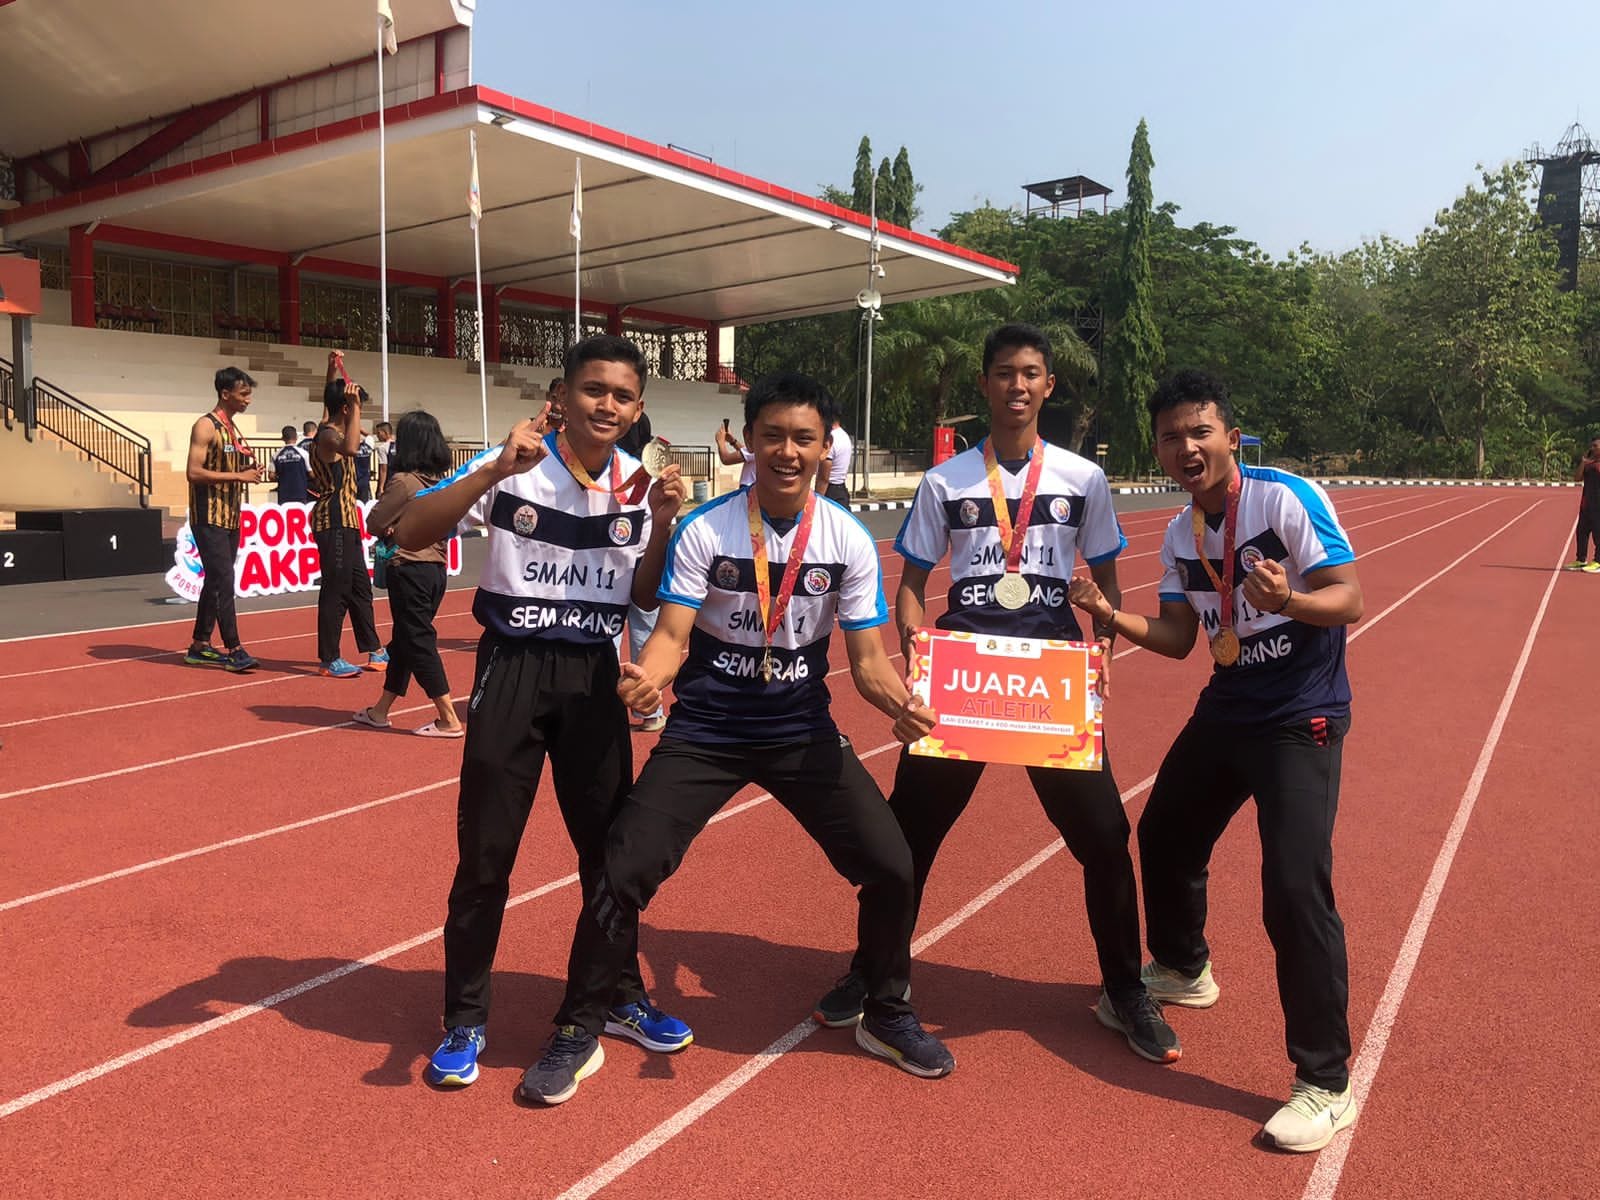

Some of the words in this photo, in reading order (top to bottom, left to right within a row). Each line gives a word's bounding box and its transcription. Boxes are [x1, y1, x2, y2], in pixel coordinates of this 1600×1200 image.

[109, 534, 118, 550] 1
[3, 551, 15, 568] 2
[1039, 545, 1054, 566] 11
[523, 561, 588, 586] SMAN
[596, 567, 615, 590] 11
[508, 605, 622, 636] SEMARANG
[943, 668, 1050, 699] JUARA
[1060, 678, 1071, 701] 1
[960, 697, 1053, 721] ATLETIK
